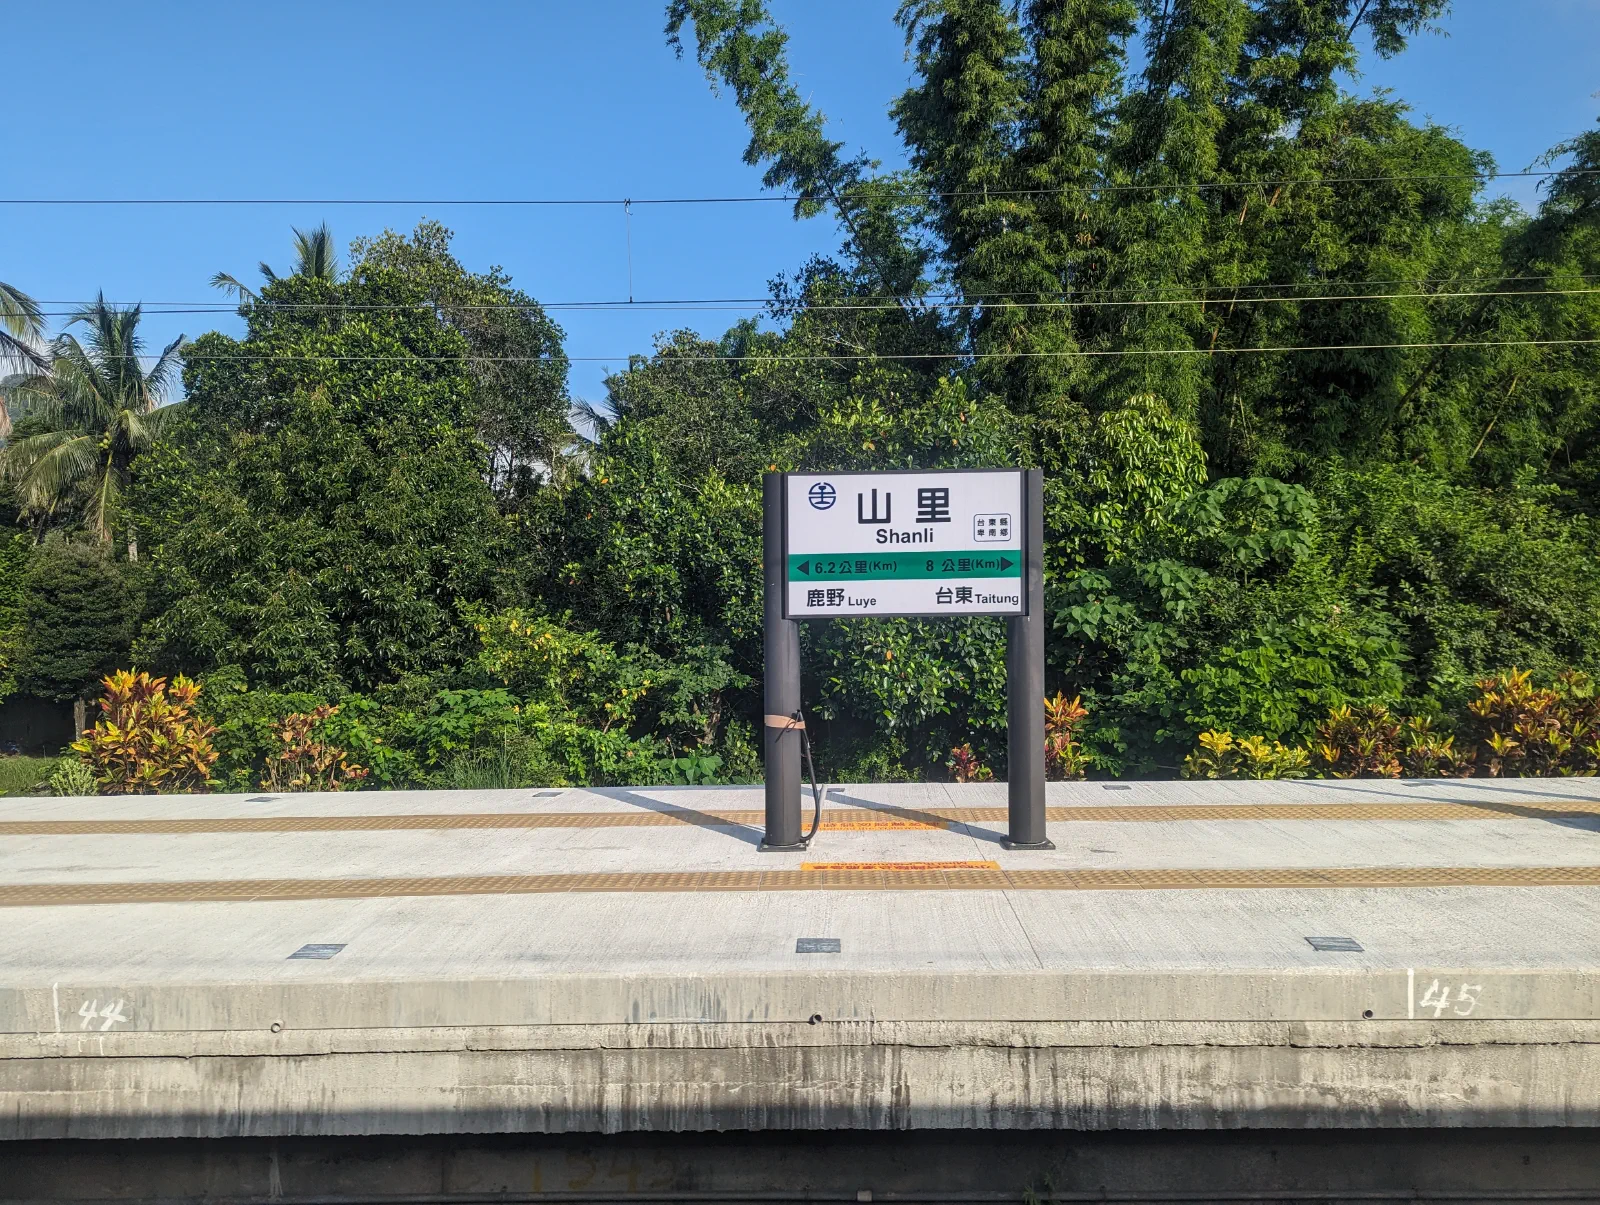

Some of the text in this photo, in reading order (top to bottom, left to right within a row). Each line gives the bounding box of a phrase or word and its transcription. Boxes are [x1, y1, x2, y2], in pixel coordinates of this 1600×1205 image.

[875, 527, 934, 544] Shanli
[806, 588, 877, 608] 鹿野 Luye
[935, 586, 1019, 606] 台東 Taitung
[1419, 978, 1484, 1018] 45
[78, 998, 128, 1032] 44
